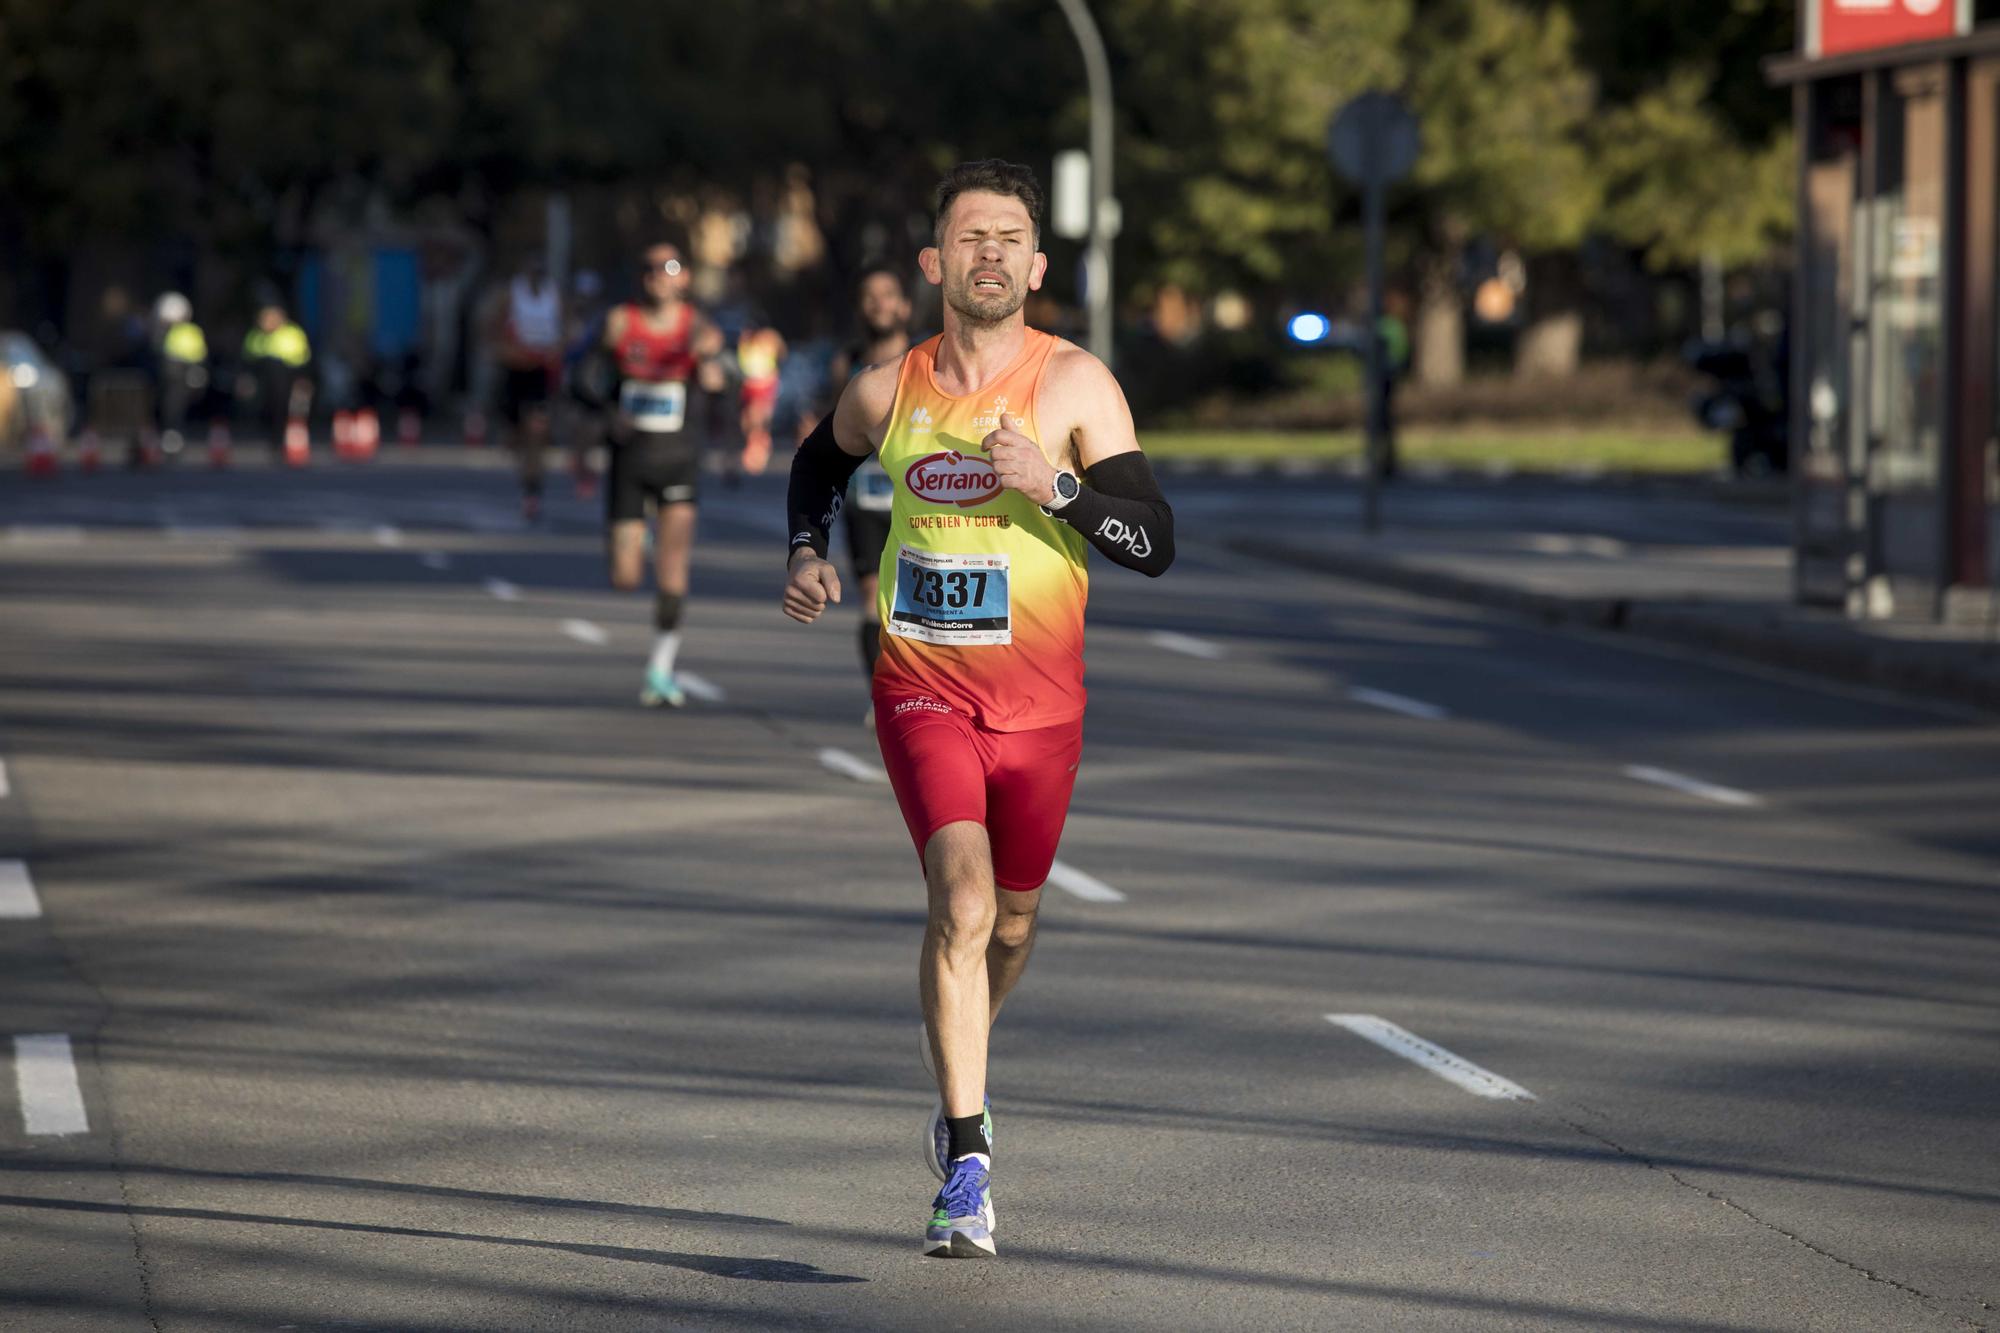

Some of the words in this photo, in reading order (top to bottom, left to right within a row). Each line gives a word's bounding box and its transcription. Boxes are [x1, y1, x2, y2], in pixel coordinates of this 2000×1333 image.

[973, 416, 1025, 427] SERRO
[914, 466, 998, 491] Serrano
[910, 517, 933, 528] COME
[936, 517, 960, 528] BIEN
[965, 517, 971, 527] Y
[975, 515, 1009, 527] CORRE
[912, 566, 987, 608] 2337
[895, 701, 952, 711] SERRANO
